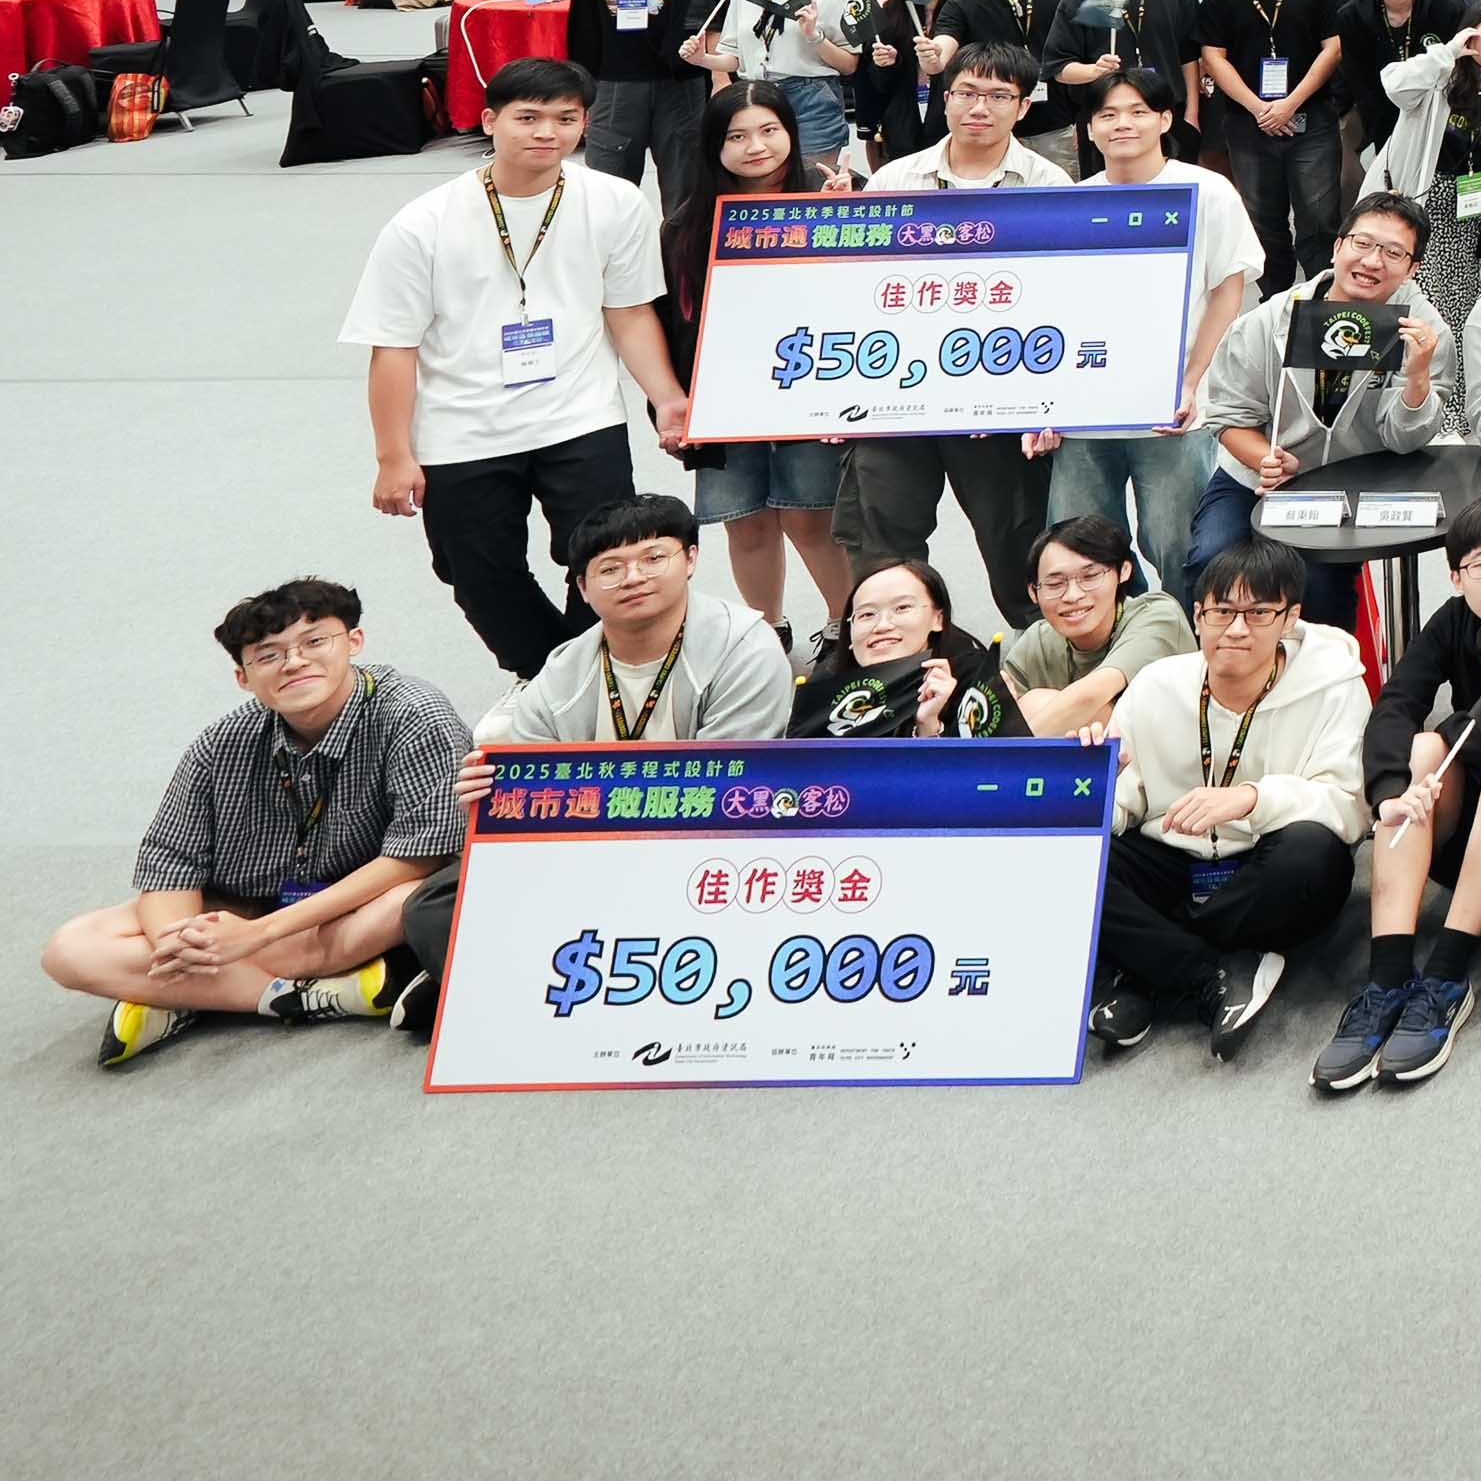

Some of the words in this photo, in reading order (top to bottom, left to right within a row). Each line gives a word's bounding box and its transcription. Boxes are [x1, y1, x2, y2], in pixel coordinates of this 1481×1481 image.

[727, 203, 914, 222] 2025臺北秋季程式設計節
[880, 280, 1015, 308] 佳作獎金
[772, 325, 1065, 390] $50,000
[1076, 340, 1107, 369] 元
[494, 760, 747, 781] 2025臺北秋季程式設計節
[696, 867, 872, 905] 佳作獎金
[546, 929, 937, 1020] $50,000
[947, 956, 991, 997] 元
